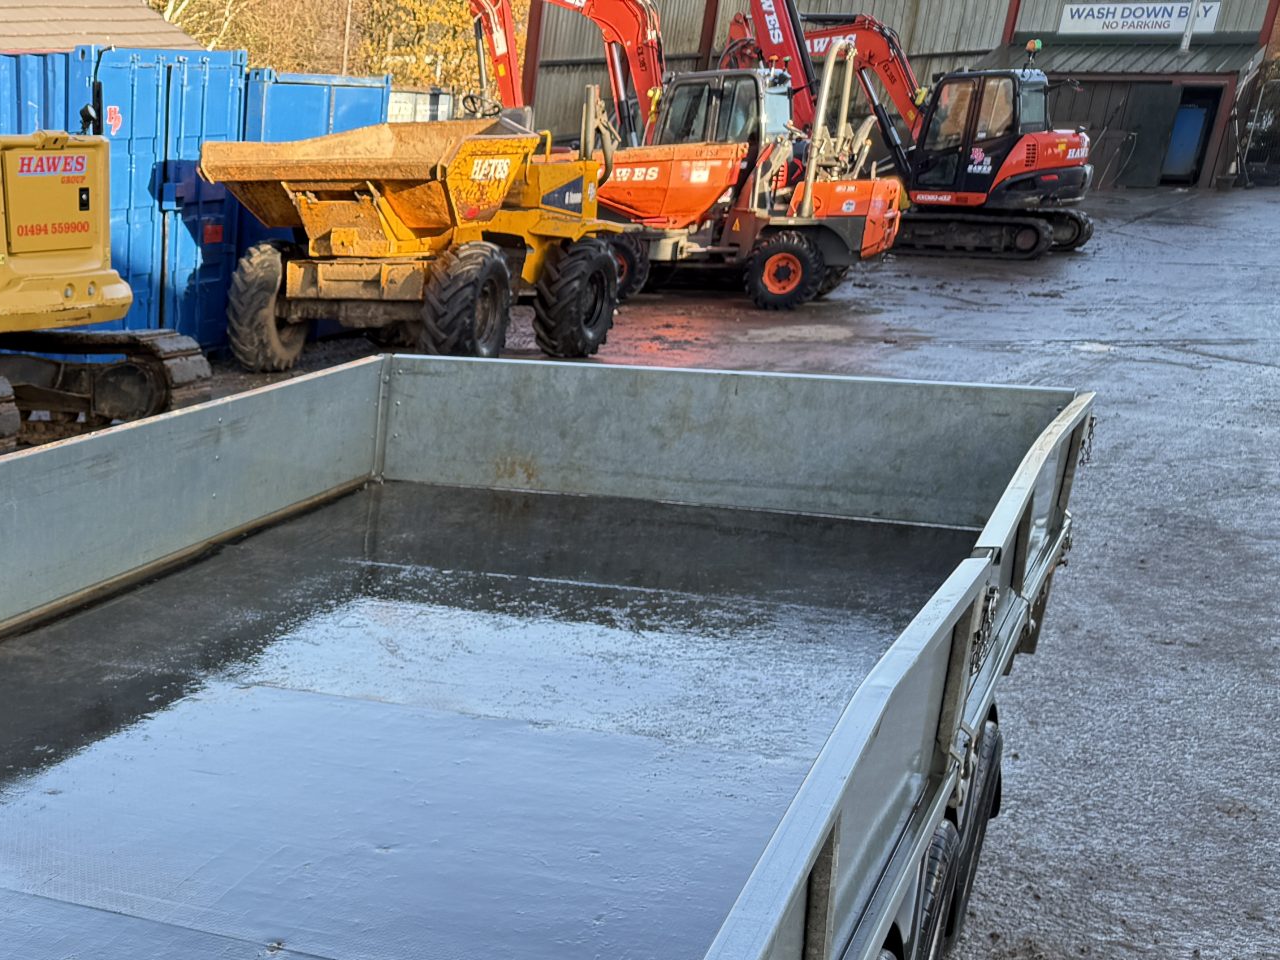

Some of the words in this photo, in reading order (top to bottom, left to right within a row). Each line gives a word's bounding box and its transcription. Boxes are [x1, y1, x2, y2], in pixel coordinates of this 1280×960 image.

[1070, 6, 1117, 20] WASH
[1120, 5, 1174, 19] DOWN
[1177, 5, 1214, 18] BY
[1101, 20, 1119, 30] NO
[1121, 20, 1171, 30] PARKING
[17, 155, 87, 174] HAWES
[17, 223, 49, 238] 01494
[51, 221, 90, 235] 559900
